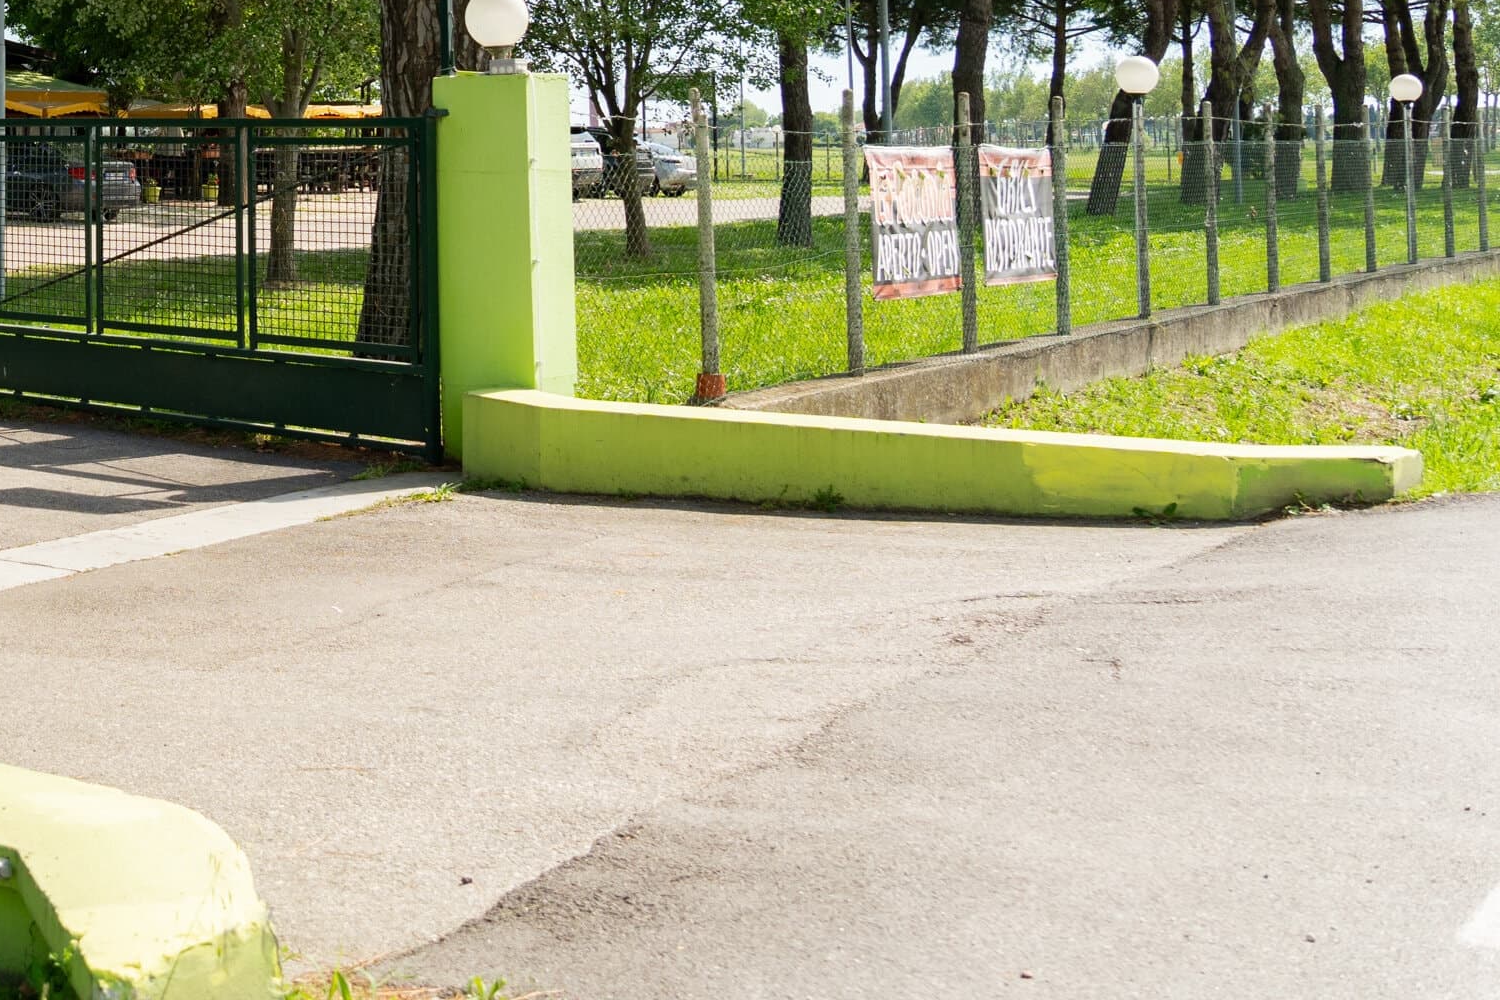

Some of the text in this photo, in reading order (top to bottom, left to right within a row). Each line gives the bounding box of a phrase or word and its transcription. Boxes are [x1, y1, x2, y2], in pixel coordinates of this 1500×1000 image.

[877, 229, 959, 281] APERTO OPEN
[985, 216, 1054, 273] RISTORANTE
